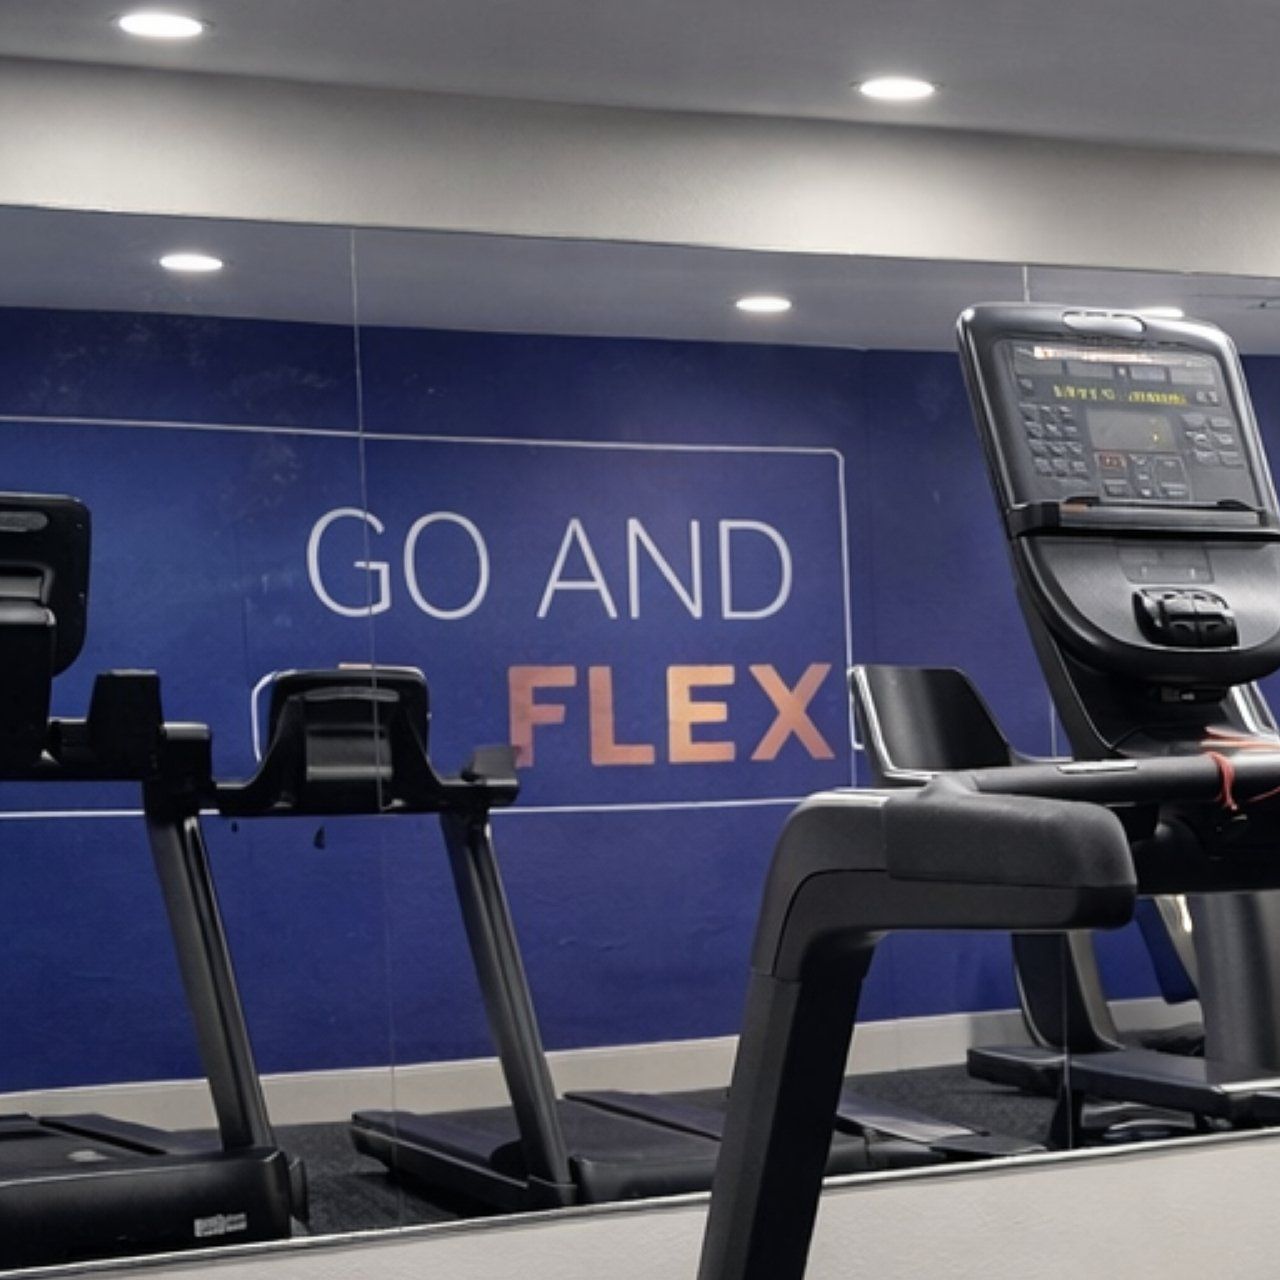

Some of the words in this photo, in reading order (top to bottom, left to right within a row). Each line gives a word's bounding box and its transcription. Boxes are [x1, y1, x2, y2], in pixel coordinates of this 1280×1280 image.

[306, 507, 491, 620] GO
[536, 517, 793, 620] AND
[508, 663, 835, 768] FLEX
